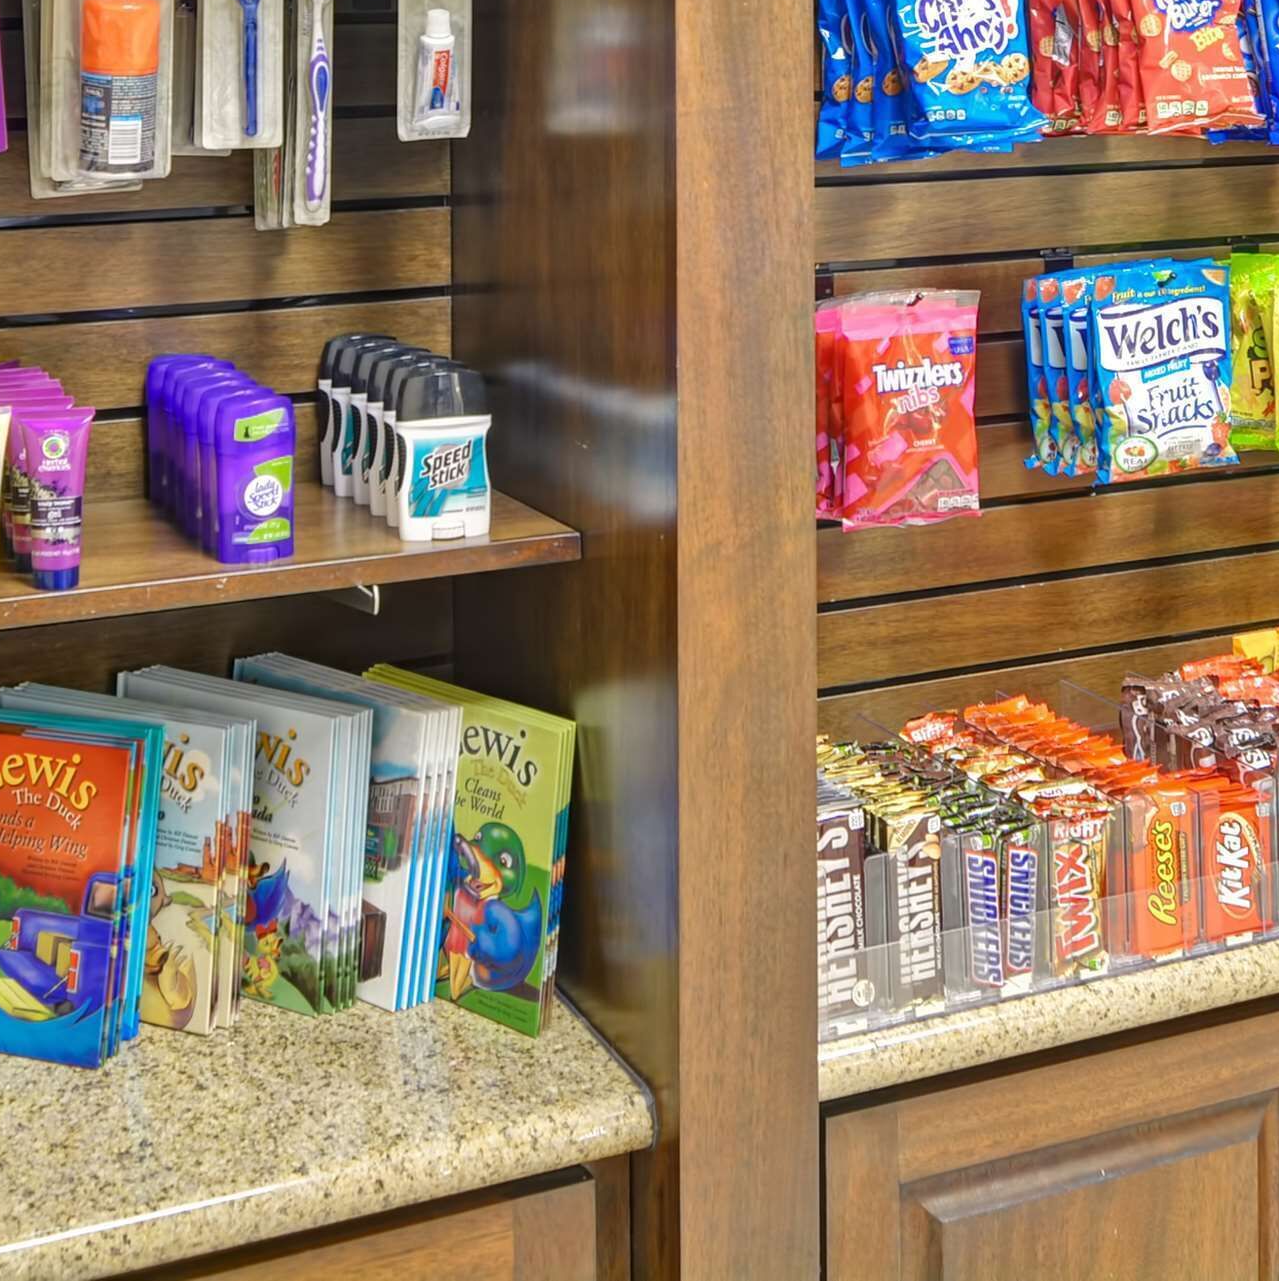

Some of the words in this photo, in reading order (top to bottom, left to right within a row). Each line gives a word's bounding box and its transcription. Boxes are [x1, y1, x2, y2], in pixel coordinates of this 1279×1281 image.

[1104, 305, 1219, 360] Welch's
[872, 357, 966, 394] Twizzlers
[1147, 377, 1202, 412] Fruit
[895, 385, 941, 414] nibs
[1136, 398, 1216, 435] Snacks
[458, 725, 539, 789] ewis
[270, 769, 300, 809] Duck
[464, 777, 503, 802] Cleans
[469, 794, 505, 821] World
[12, 787, 43, 806] The
[46, 791, 82, 830] Duck
[25, 817, 34, 828] a
[49, 835, 89, 859] Wing
[1054, 821, 1104, 840] RIGHT
[1148, 821, 1177, 925] Reese's
[818, 826, 858, 1005] HERSHEY'S
[852, 874, 864, 933] CHOCOLATE
[1009, 850, 1037, 970] SNICKERS
[1054, 844, 1099, 960] TWIX
